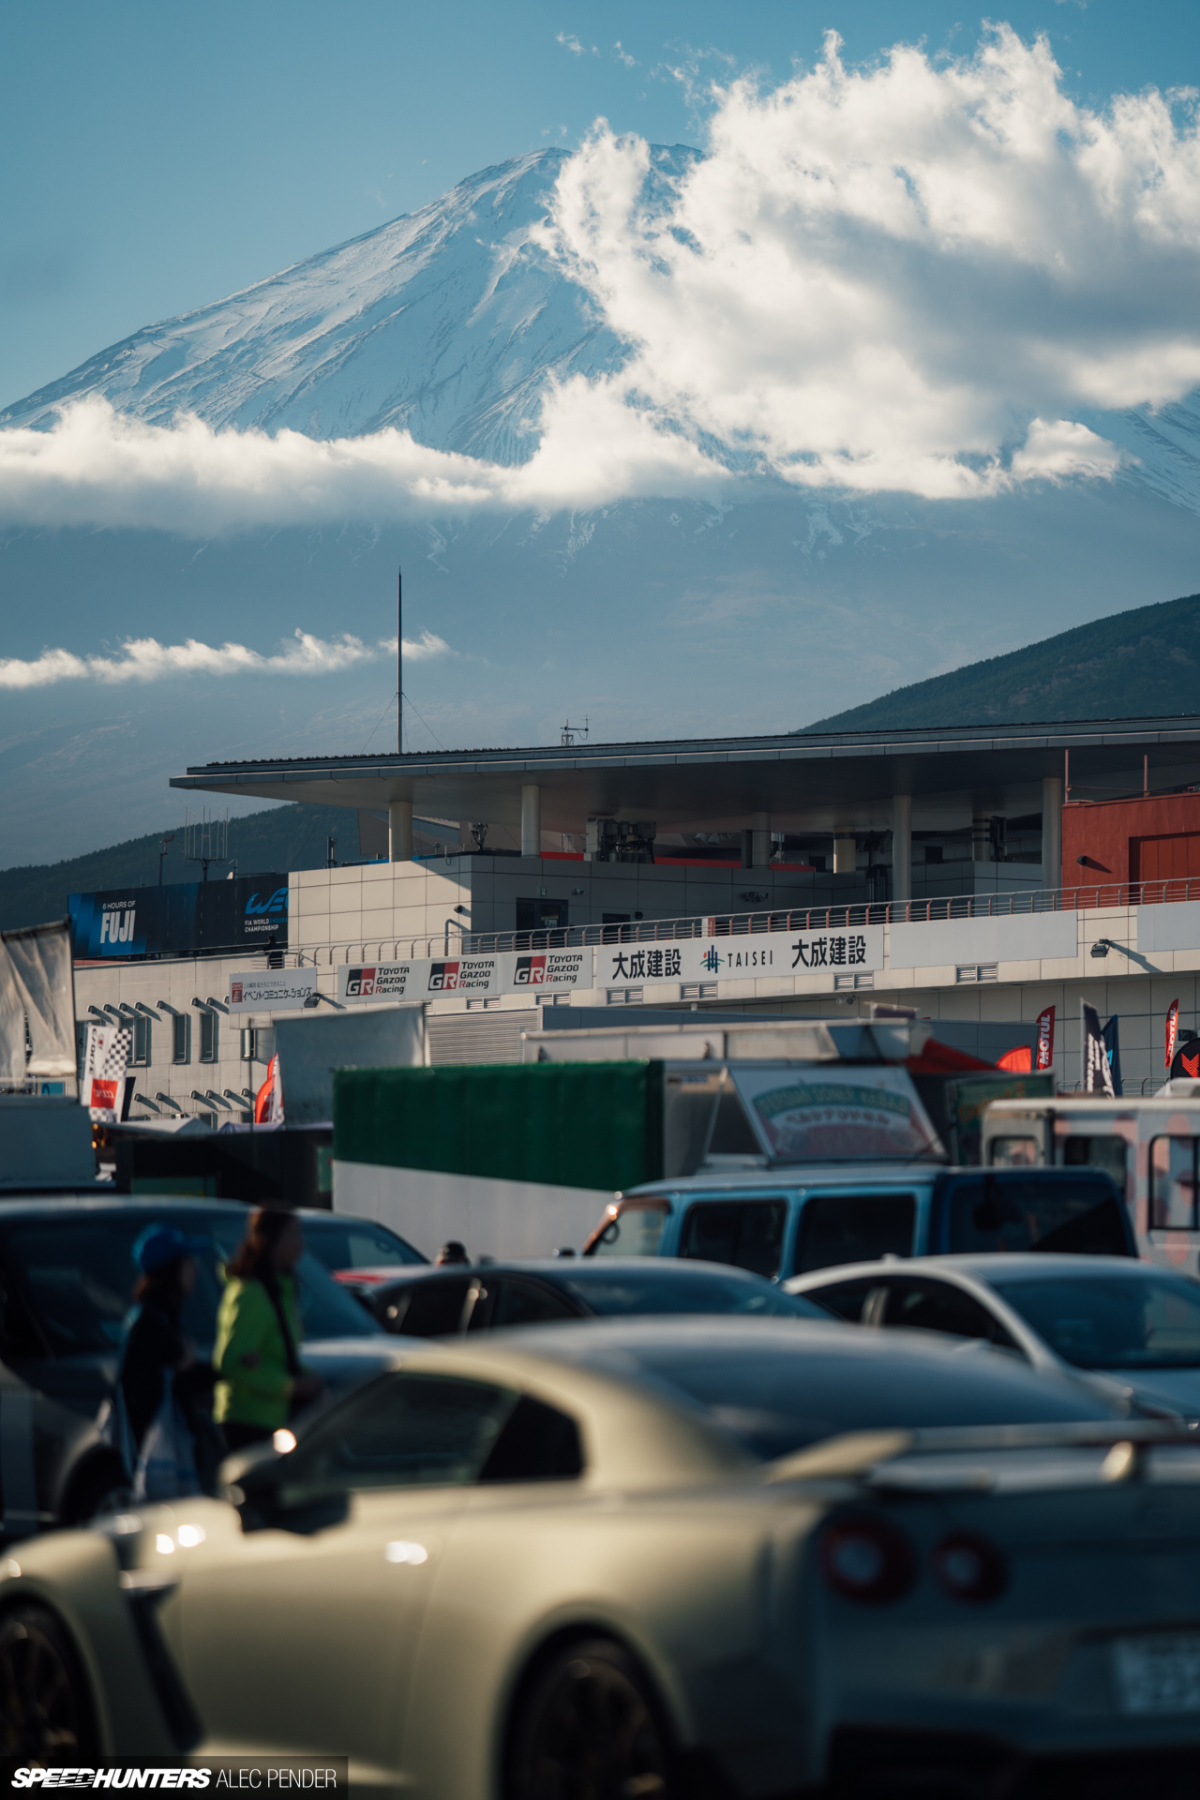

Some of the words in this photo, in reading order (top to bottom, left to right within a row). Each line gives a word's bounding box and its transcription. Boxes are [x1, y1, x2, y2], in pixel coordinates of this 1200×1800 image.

[107, 901, 127, 910] HOURS
[127, 900, 136, 908] OF
[245, 887, 289, 915] WE
[100, 909, 136, 944] FUJI
[253, 918, 270, 926] WORLD
[244, 924, 279, 933] CHAMPIONSHIP
[791, 935, 866, 969] 大成建設
[548, 954, 583, 964] TOYOTA
[612, 948, 682, 980] 大成建設
[727, 950, 773, 968] TAISEI
[461, 960, 495, 970] TOYOTA
[547, 964, 579, 973] GAZOO
[378, 966, 410, 976] TOYOTA
[459, 970, 491, 979] GAZOO
[376, 976, 406, 985] GAZOO
[546, 973, 577, 983] Racing
[459, 979, 489, 989] Racing
[375, 985, 405, 995] Racing
[1039, 1014, 1051, 1066] MOTUL
